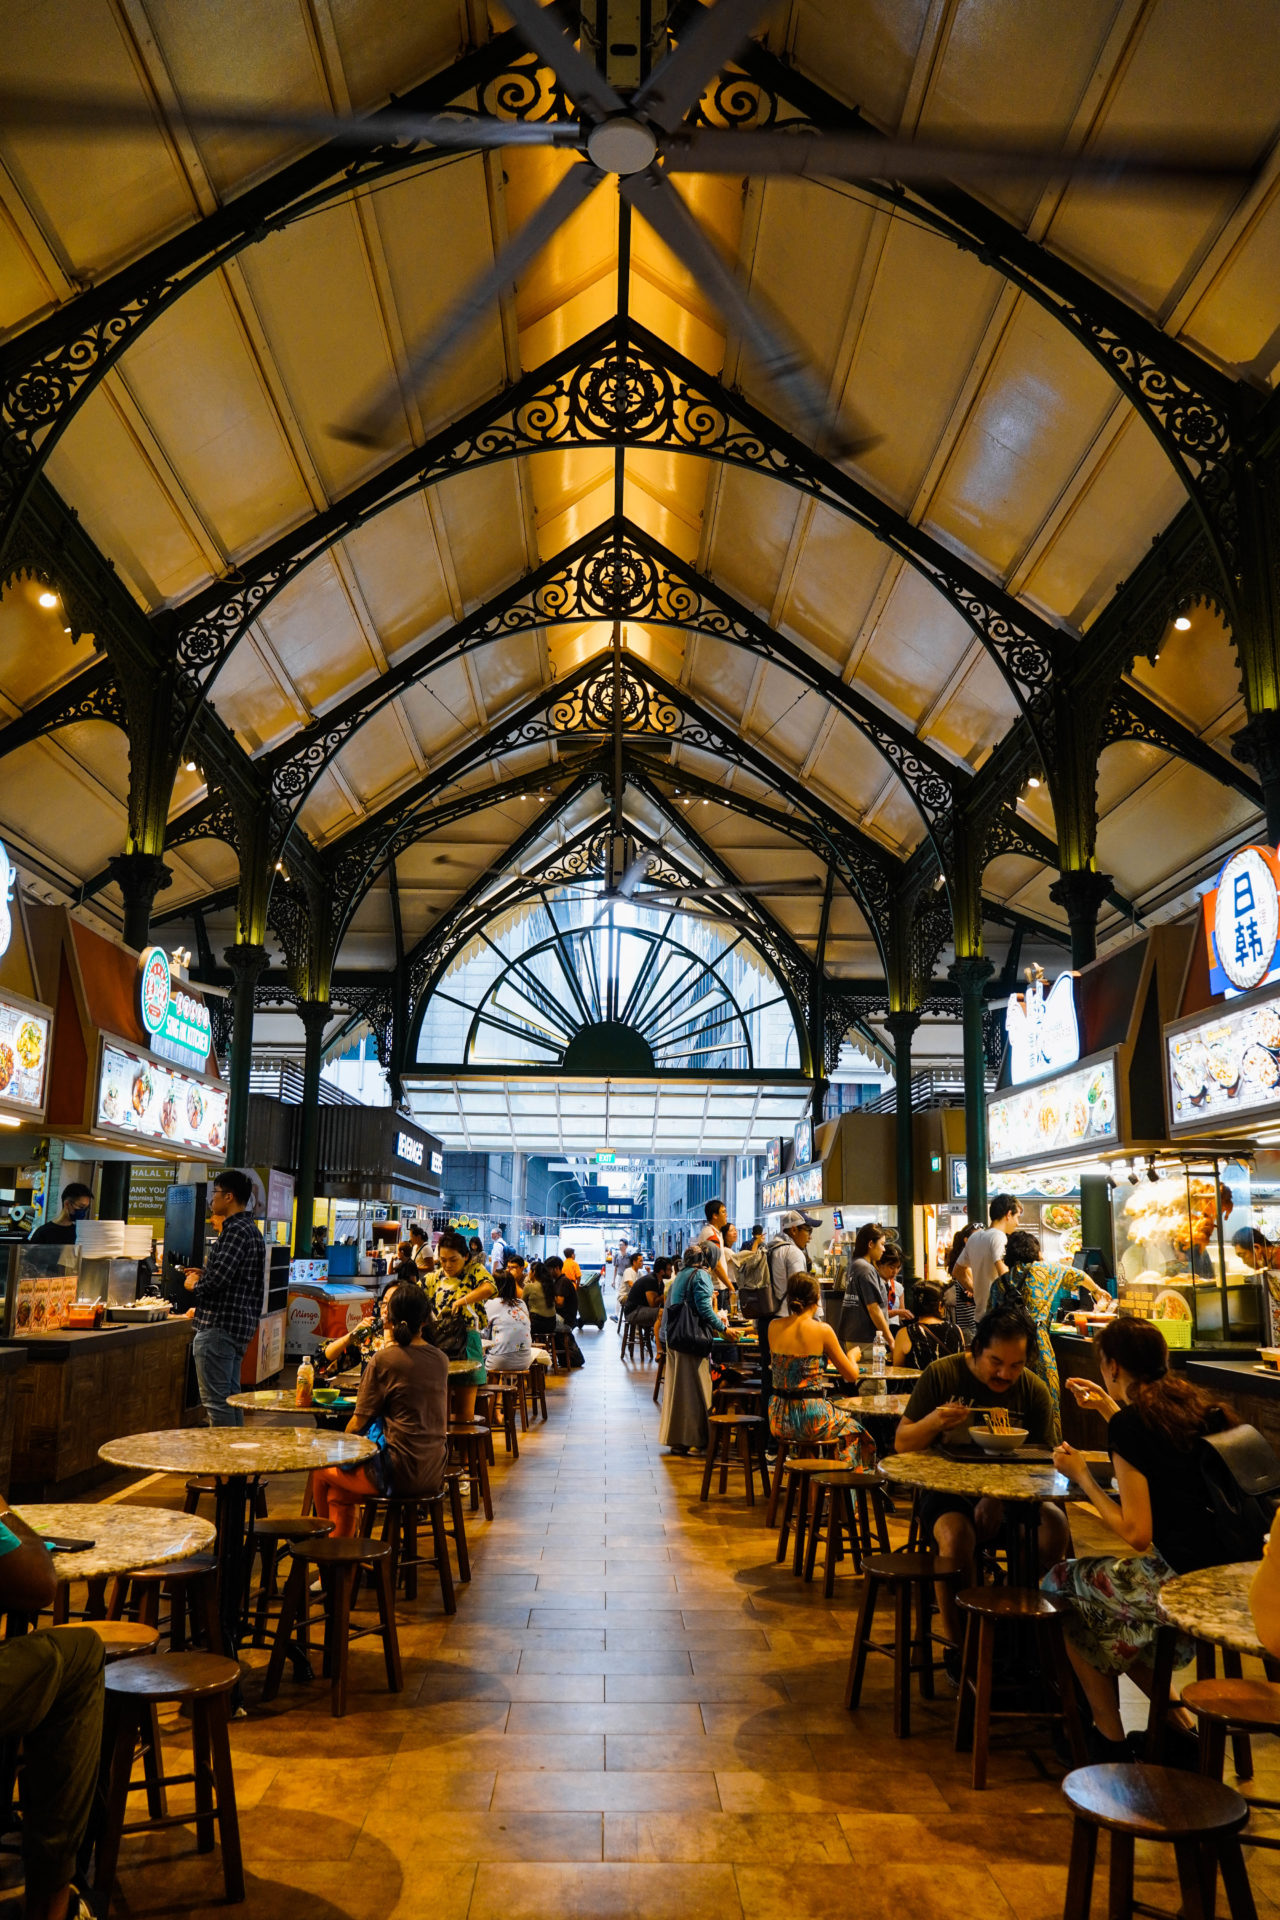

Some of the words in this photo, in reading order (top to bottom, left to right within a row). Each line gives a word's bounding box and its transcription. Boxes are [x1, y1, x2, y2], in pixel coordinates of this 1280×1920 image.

[1234, 871, 1264, 967] 日韩
[397, 1131, 424, 1166] BEVERAGES
[598, 1154, 612, 1162] EXIT
[131, 1169, 161, 1177] HALAL
